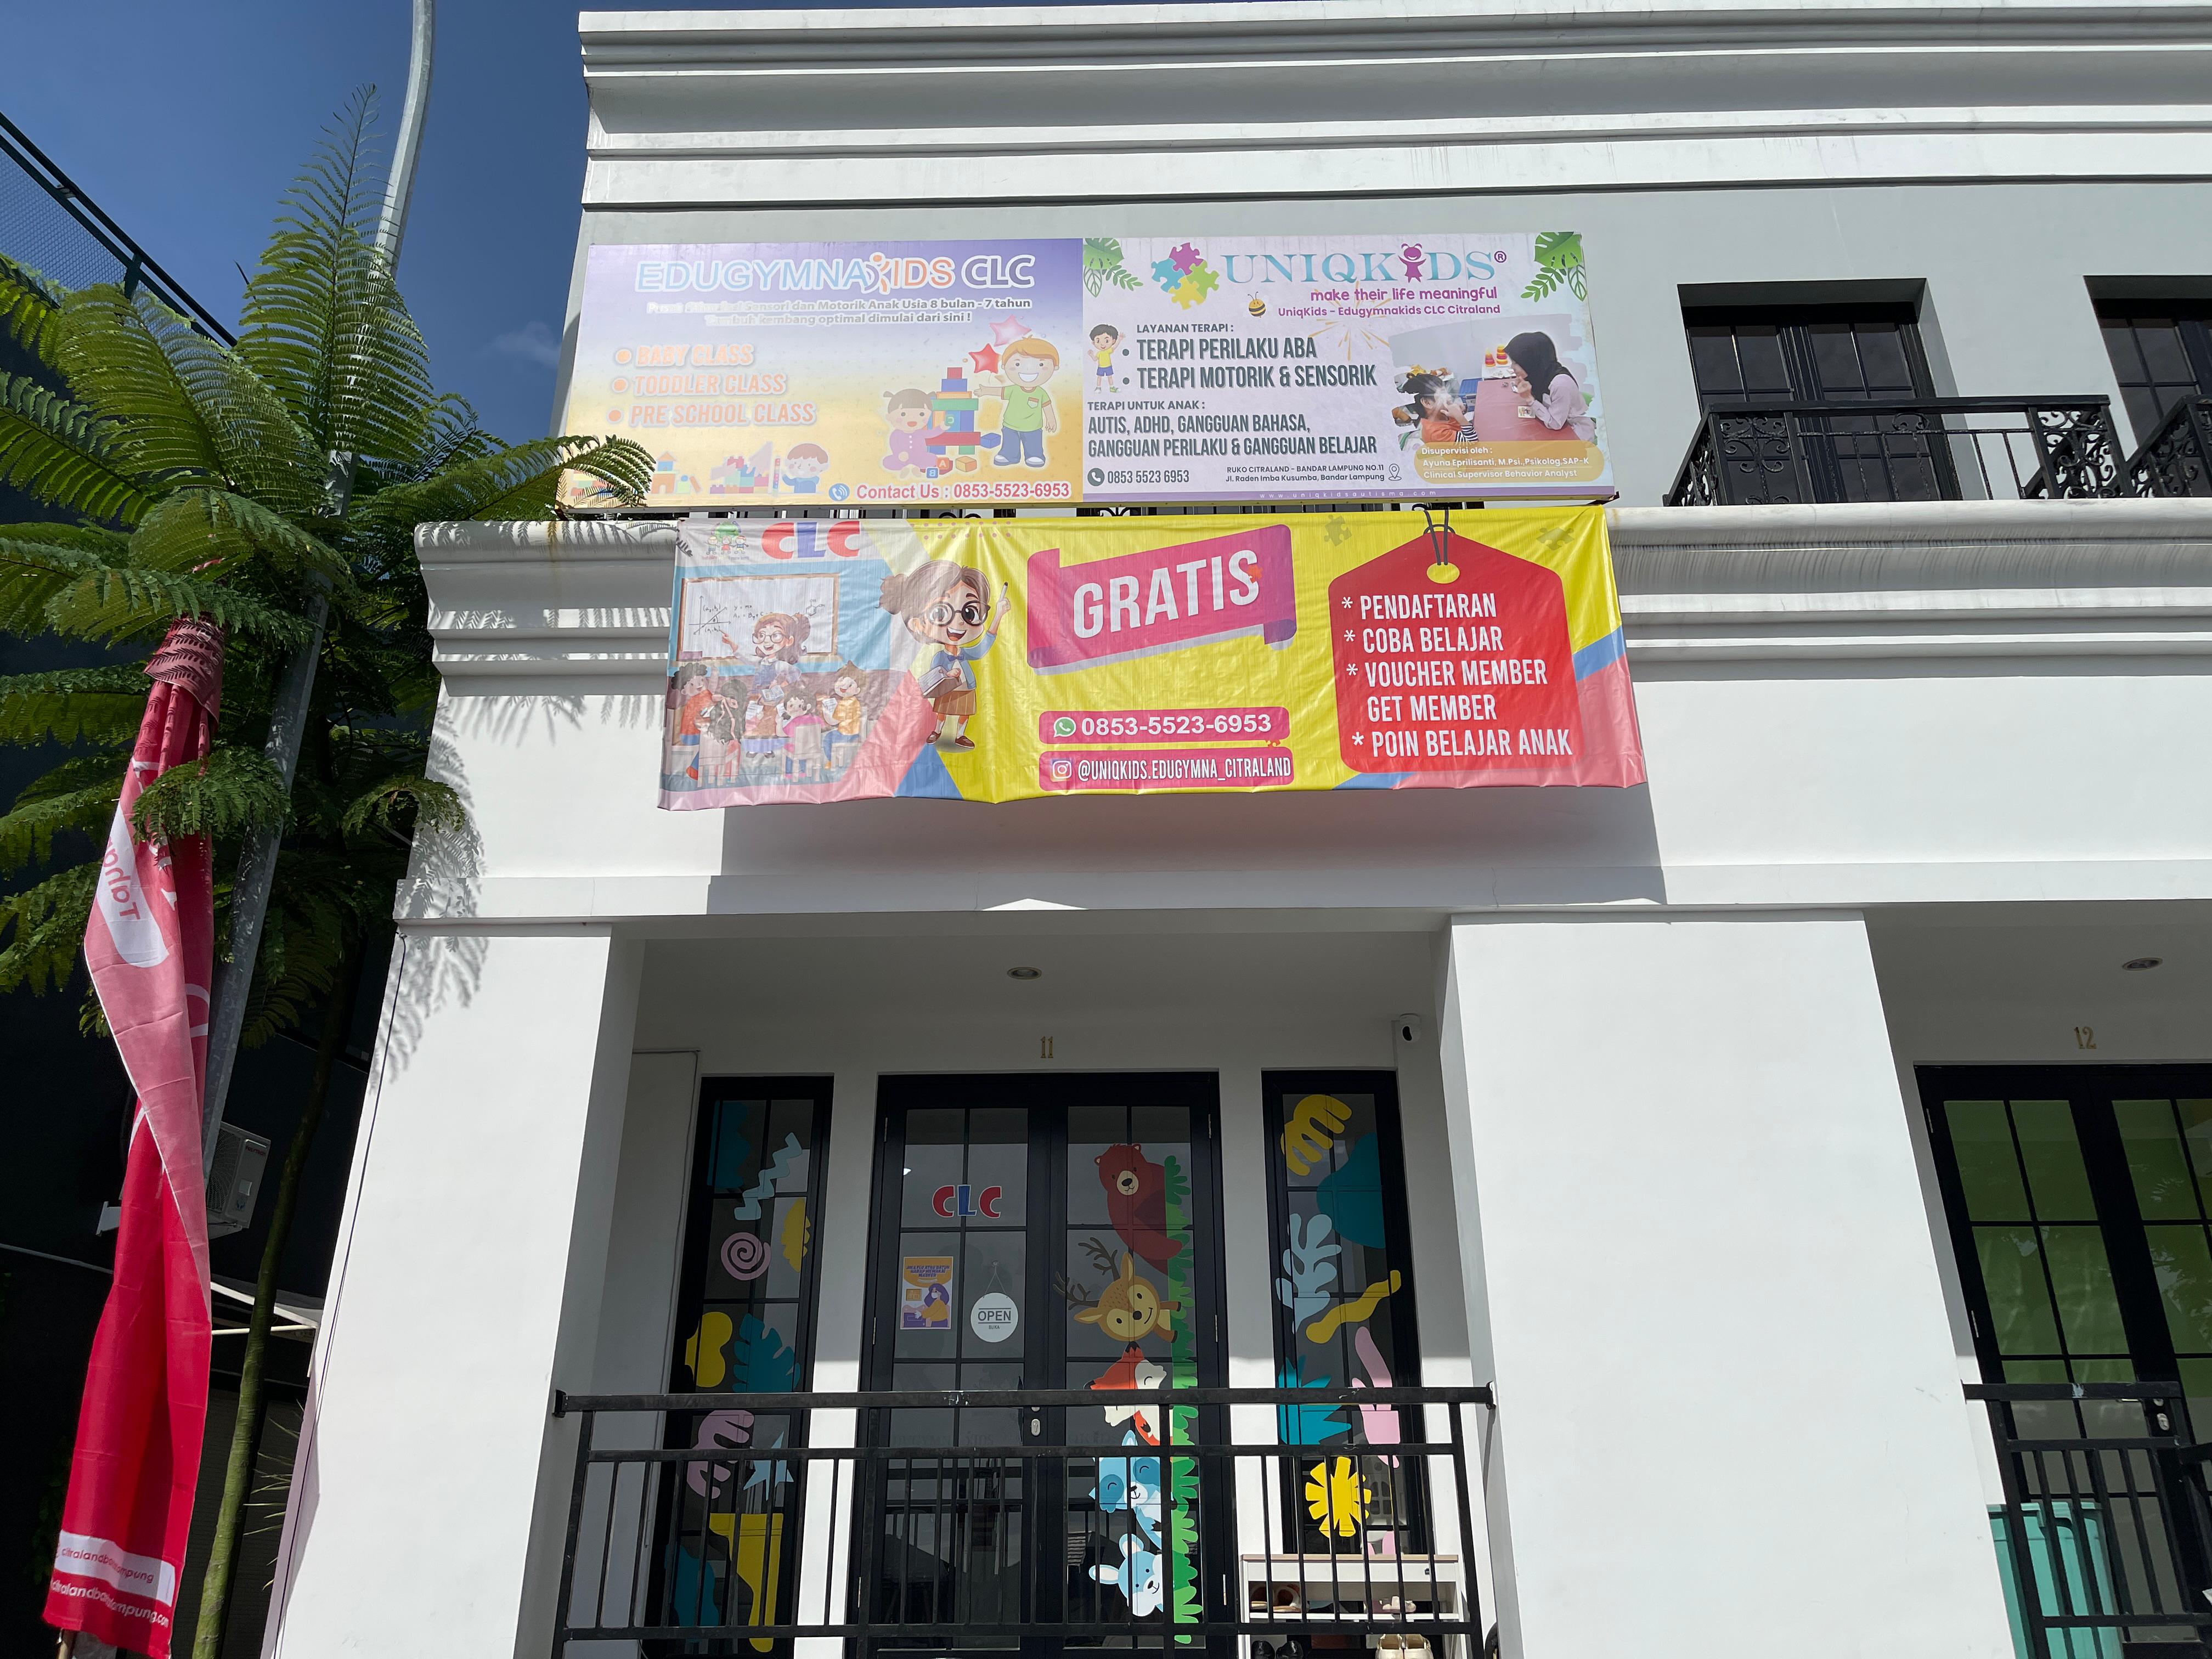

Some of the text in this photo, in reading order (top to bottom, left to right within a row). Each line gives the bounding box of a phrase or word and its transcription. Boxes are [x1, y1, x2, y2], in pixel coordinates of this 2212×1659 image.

[964, 257, 1032, 286] CLC
[792, 302, 815, 311] dan
[818, 301, 865, 310] Motorik
[868, 300, 899, 309] Anak
[902, 300, 928, 308] Usia
[930, 300, 938, 308] 8
[940, 299, 975, 308] bulan
[985, 300, 992, 308] 7
[995, 298, 1031, 308] tahun
[1311, 286, 1498, 302] make their life meaningful
[759, 314, 816, 326] kembang
[818, 314, 865, 325] optimal
[868, 313, 913, 323] dimulai
[916, 313, 940, 322] dari
[943, 313, 964, 321] sini
[1278, 306, 1328, 319] UniqKids
[1338, 305, 1422, 318] Edugymnakids
[1423, 306, 1446, 315] CLC
[1447, 304, 1501, 314] Citraland
[1136, 324, 1189, 333] LAYANAN
[1191, 324, 1228, 332] TERAPI
[637, 345, 754, 365] BABY CLASS
[1136, 336, 1317, 360] TERAPI PERILAKU ABA
[635, 374, 785, 394] TODDLER CLASS
[1136, 364, 1378, 389] TERAPI MOTORIK & SENSORIK
[631, 403, 814, 424] PRE SCHOOL CLASS
[1087, 402, 1126, 411] TERAPI
[1127, 401, 1165, 410] UNTUK
[1167, 400, 1200, 410] ANAK
[1088, 414, 1311, 436] AUTIS, ADHD, GANGGUAN BAHASA,
[1088, 436, 1378, 458] GANGGUAN PERILAKU & GANGGUAN BELAJAR
[1422, 447, 1469, 457] Disupervisi
[1422, 459, 1451, 469] Ayuna
[1452, 459, 1497, 468] Eprilisanti,
[1424, 469, 1578, 480] Clinical Supervisor Behavior Analyst
[1107, 470, 1190, 484] 0853 5523 6953
[1280, 474, 1319, 483] Kusumba,
[1349, 473, 1385, 483] Lampung
[856, 484, 916, 500] Contact
[919, 484, 940, 499] Us
[953, 483, 1070, 498] 0853-5523-6953
[761, 520, 861, 560] CLC
[1073, 549, 1261, 639] GRATIS
[1361, 592, 1497, 620] PENDAFTARAN
[1363, 626, 1504, 653] COBA BELAJAR
[1364, 658, 1548, 687] VOUCHER MEMBER
[1367, 694, 1497, 722] GET MEMBER
[1081, 714, 1272, 737] 0853-5523-6953
[1372, 729, 1573, 757] POIN BELAJAR ANAK
[1077, 757, 1292, 781] @UNIQKIDS.EDUGYMNA_CITRALAND
[1040, 1036, 1054, 1059] 11
[2073, 1026, 2097, 1049] 12
[932, 1184, 1002, 1218] CLC
[978, 1310, 1012, 1322] OPEN
